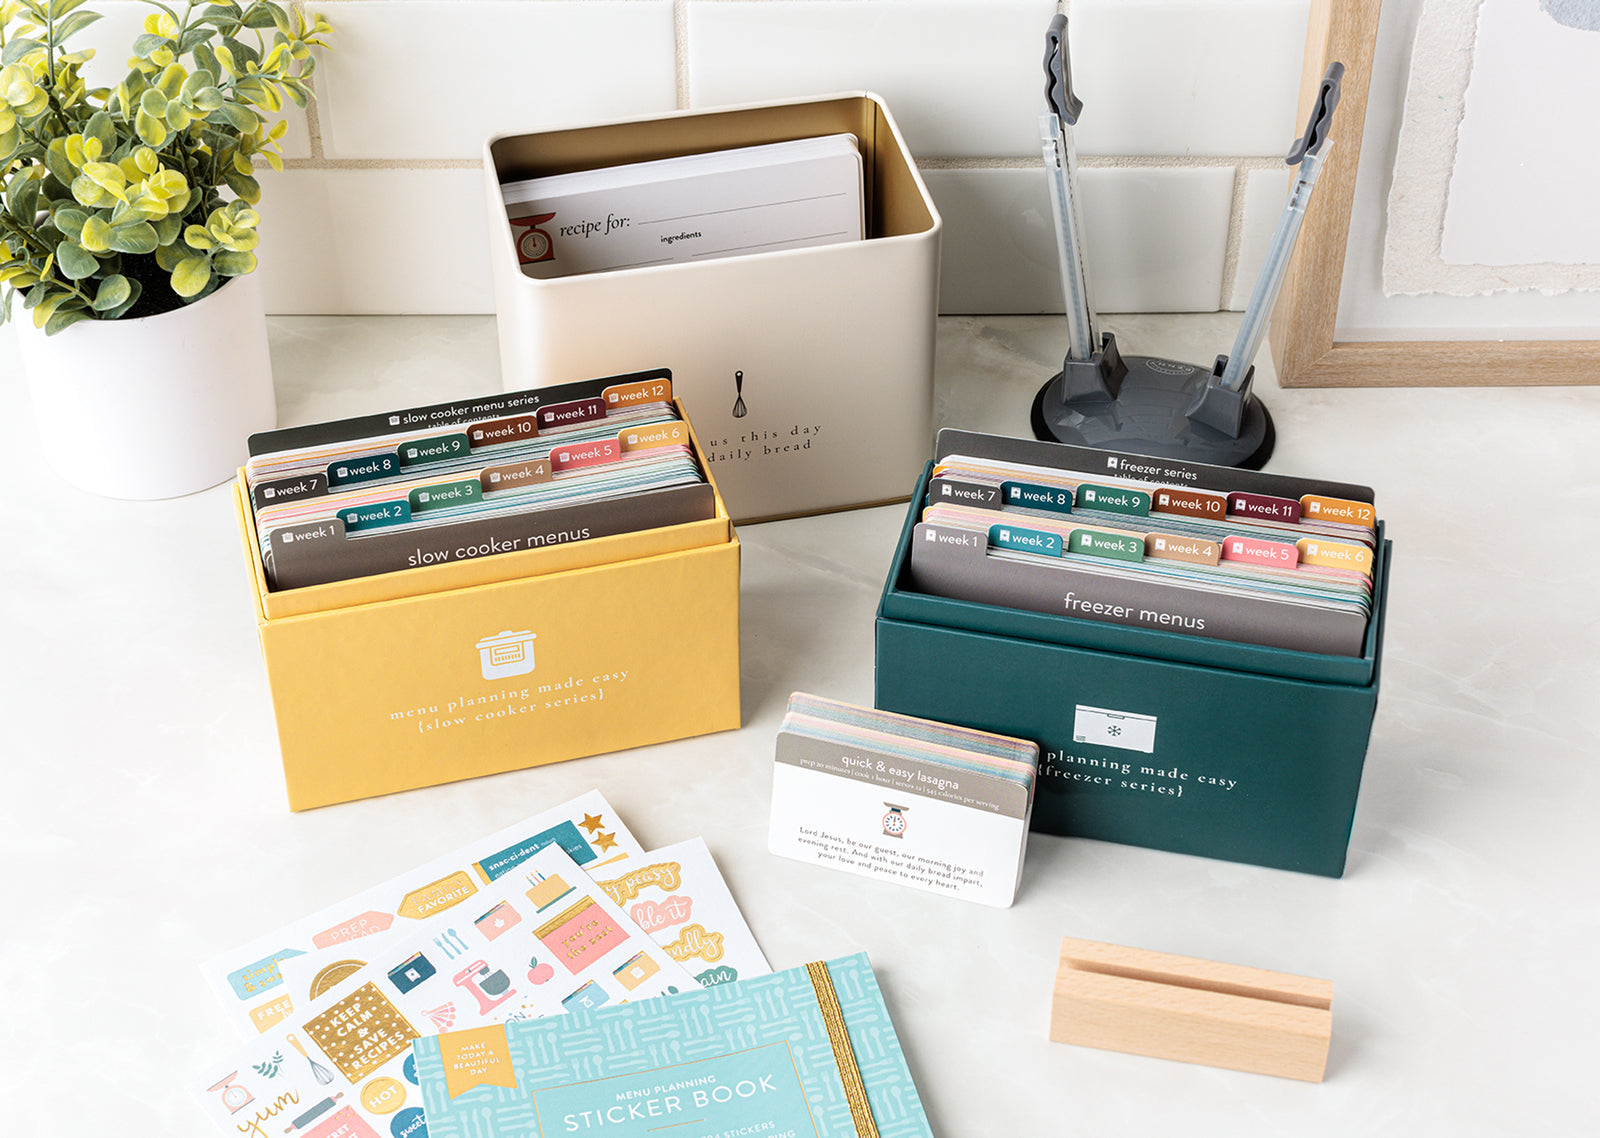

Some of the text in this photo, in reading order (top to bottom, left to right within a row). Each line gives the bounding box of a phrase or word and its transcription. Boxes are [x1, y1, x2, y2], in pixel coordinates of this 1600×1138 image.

[560, 213, 630, 238] recipe for:
[660, 231, 702, 244] ingredients
[620, 385, 664, 401] week 12
[402, 394, 540, 425] slow cooker menu series
[556, 404, 597, 421] week 11
[485, 421, 532, 438] week 10
[639, 427, 680, 443] week 6
[710, 425, 821, 447] us this day
[419, 440, 461, 457] week 9
[571, 445, 612, 461] week 5
[707, 439, 811, 463] daily bread
[349, 459, 392, 476] week 8
[502, 464, 544, 481] week 4
[1119, 459, 1198, 481] freezer series
[276, 479, 318, 496] week 7
[431, 485, 473, 502] week 3
[954, 487, 996, 502] week 7
[1023, 490, 1066, 505] week 8
[1098, 492, 1141, 508] week 9
[1171, 496, 1220, 513] week 10
[359, 506, 402, 522] week 2
[1248, 502, 1292, 517] week 11
[1322, 504, 1371, 521] week 12
[295, 525, 335, 541] week 1
[939, 532, 978, 547] week 1
[1012, 533, 1055, 549] week 2
[408, 527, 590, 566] slow cooker menus
[1094, 537, 1137, 553] week 3
[1168, 541, 1212, 557] week 4
[1245, 545, 1289, 560] week 5
[1320, 547, 1364, 562] week 6
[1064, 592, 1205, 630] freezer menus
[390, 670, 630, 720] menu planning made easy
[418, 688, 605, 734] {slow cooker series}
[841, 756, 960, 790] quick & easy lasagna
[1046, 751, 1238, 790] planning made easy
[800, 758, 816, 768] prep
[854, 771, 870, 779] cook
[875, 774, 891, 784] hour
[938, 791, 963, 801] calories
[975, 800, 1000, 811] serving
[1120, 779, 1183, 797] series}
[800, 826, 818, 837] Lord
[820, 831, 844, 844] Jesus,
[846, 838, 856, 846] be
[858, 842, 872, 850] our
[875, 846, 899, 857] guest,
[918, 857, 952, 871] morning
[953, 864, 966, 874] joy
[968, 868, 984, 877] and
[798, 837, 983, 887] evening rest. And with our daily bread impart,
[817, 852, 960, 891] your love and peace to every heart.
[625, 867, 674, 895] peasy
[412, 878, 463, 906] FAMILY
[417, 886, 470, 914] FAVORITE
[665, 900, 688, 920] it
[330, 919, 368, 942] PREP
[562, 920, 599, 948] you're
[567, 926, 613, 959] the zest
[244, 982, 257, 993] &
[330, 1003, 361, 1028] KEEP
[337, 1010, 373, 1037] CALM
[354, 1028, 388, 1054] SAVE
[357, 1027, 369, 1038] &
[352, 1031, 404, 1070] RECIPES
[461, 1042, 486, 1051] MAKE
[453, 1057, 501, 1070] BEAUTIFUL
[456, 1051, 486, 1060] TODAY
[470, 1067, 487, 1075] DAY
[616, 1074, 717, 1102] MENU PLANNING
[369, 1085, 398, 1109] HOT
[563, 1074, 777, 1132] STICKER BOOK
[237, 1089, 300, 1138] yum
[723, 1121, 775, 1138] STICKERS
